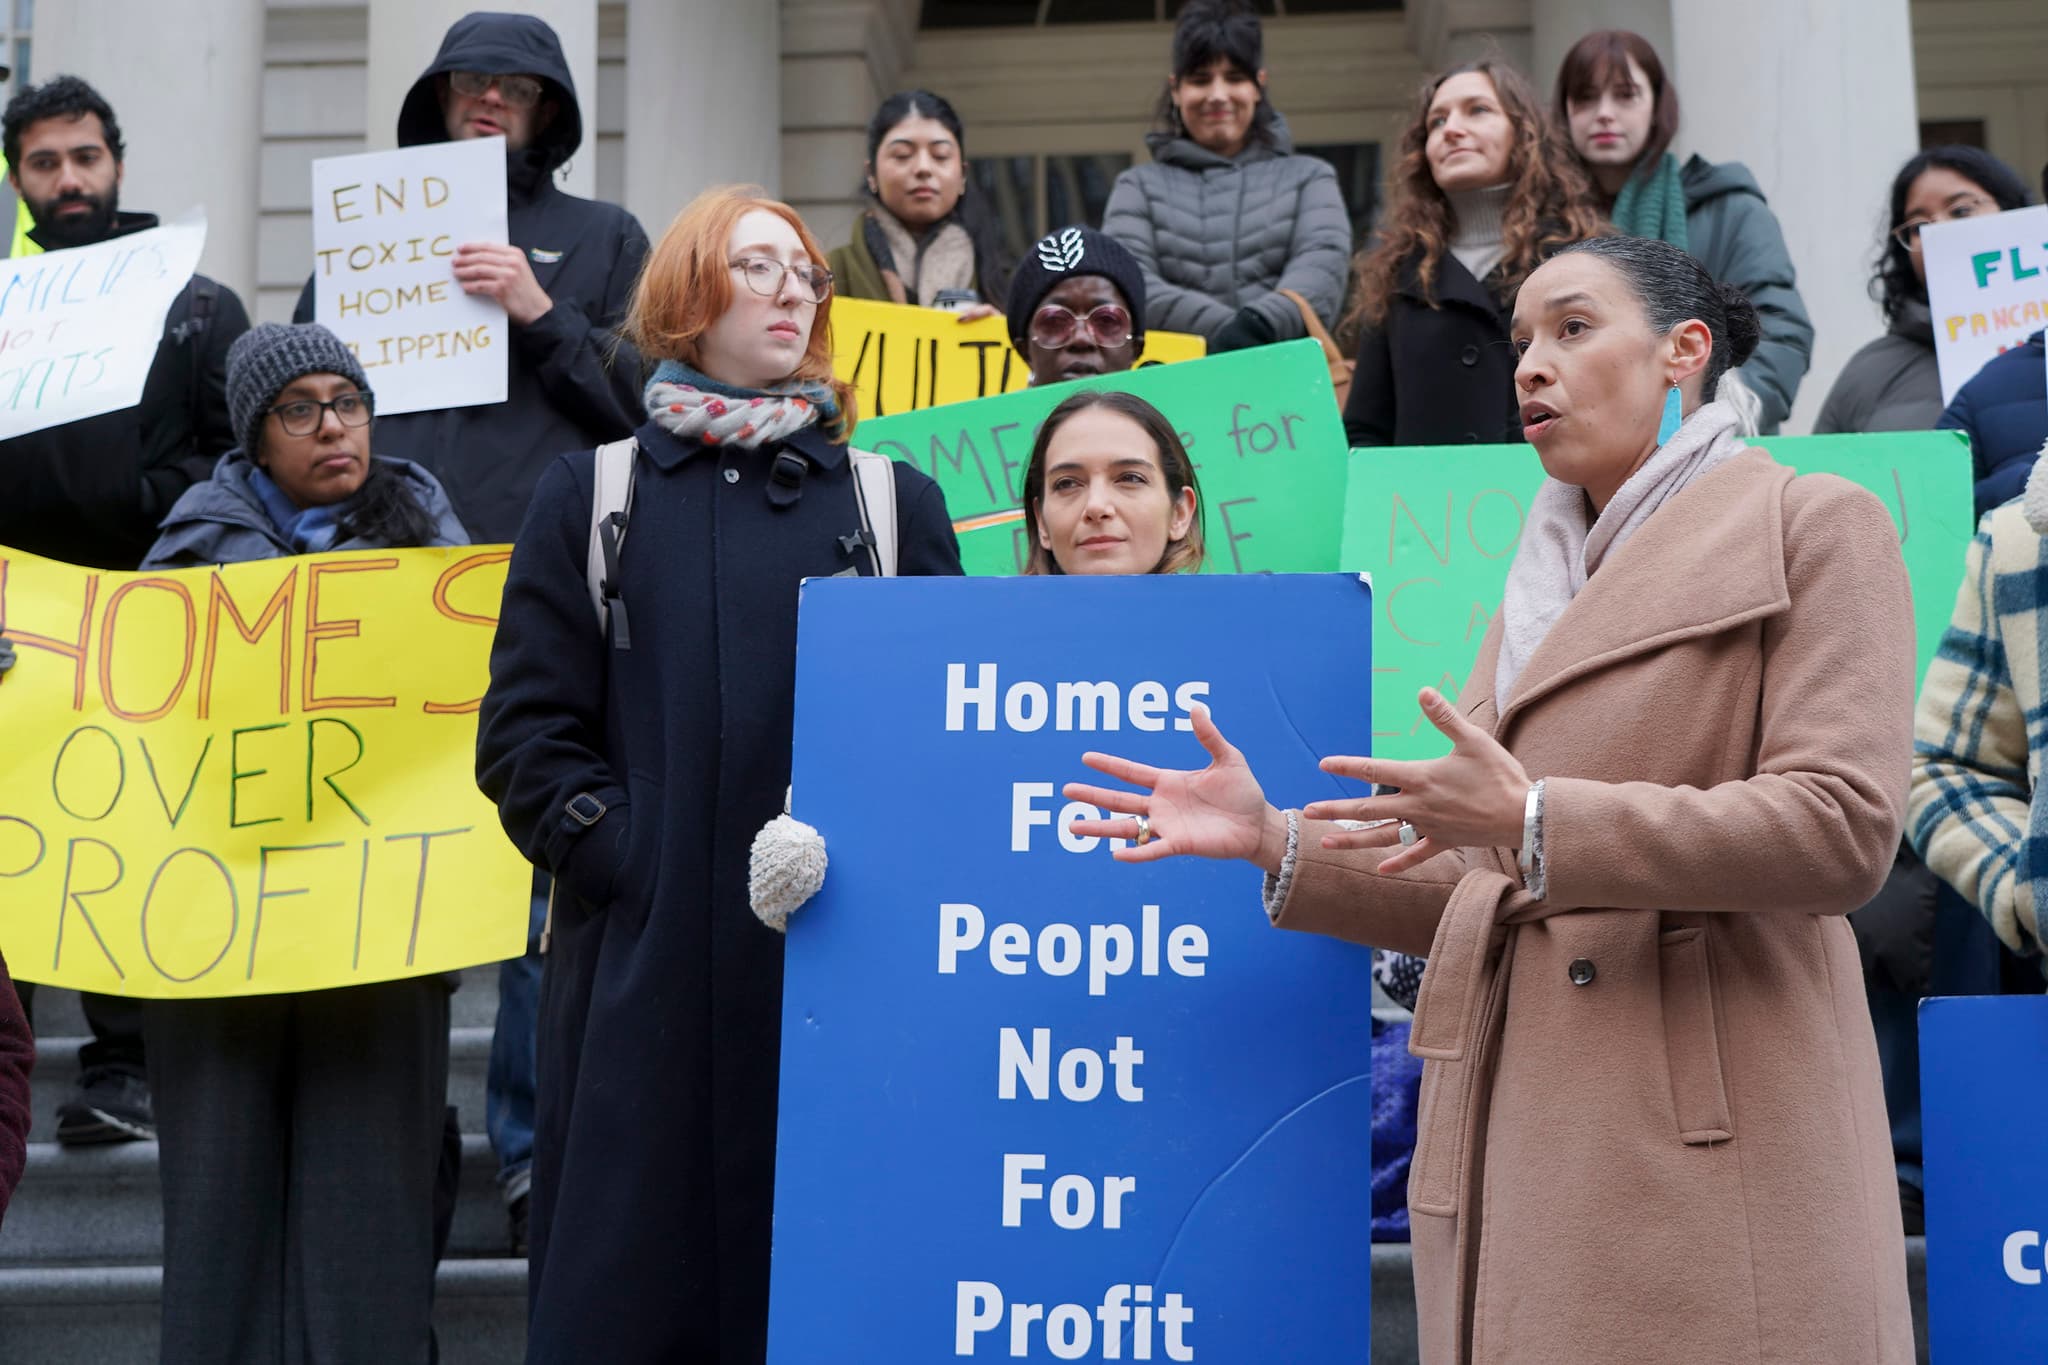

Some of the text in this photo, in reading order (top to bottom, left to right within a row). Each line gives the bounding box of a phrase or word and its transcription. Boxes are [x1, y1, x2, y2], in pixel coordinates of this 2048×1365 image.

[333, 177, 449, 223] END
[317, 235, 452, 275] TOXIC
[1971, 243, 2048, 289] FL
[339, 280, 449, 319] HOME
[1227, 403, 1305, 458] for
[0, 551, 514, 723] HOMES
[945, 663, 1212, 732] Homes
[52, 718, 371, 829] OVER
[938, 903, 1210, 996] People
[998, 1027, 1144, 1102] Not
[1002, 1153, 1136, 1230] For
[955, 1280, 1194, 1362] Profit
